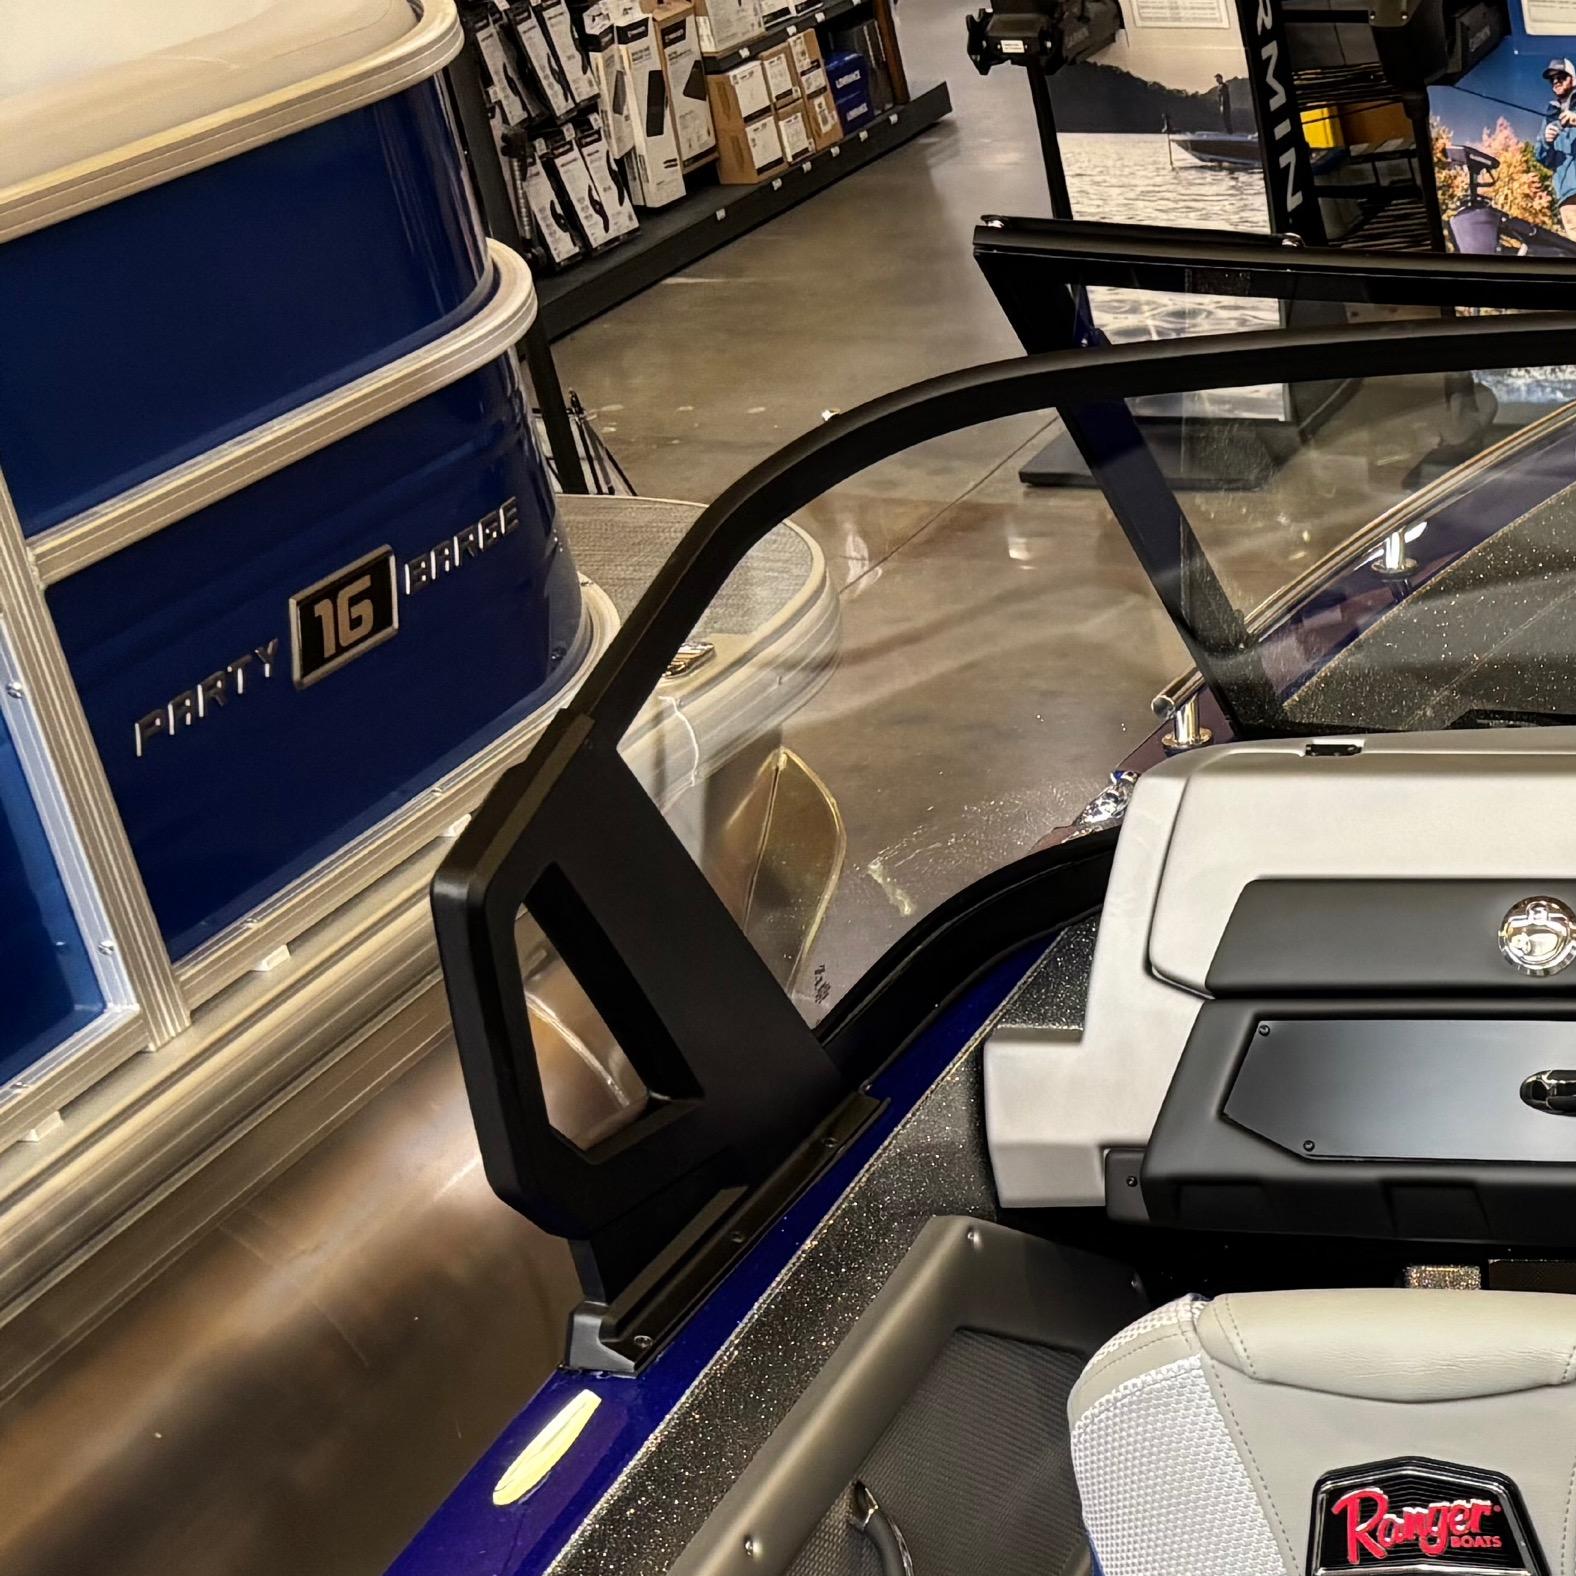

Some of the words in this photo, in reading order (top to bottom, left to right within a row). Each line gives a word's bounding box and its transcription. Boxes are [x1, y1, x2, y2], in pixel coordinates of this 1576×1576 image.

[135, 638, 279, 758] PARTY
[313, 574, 375, 659] 16
[403, 495, 521, 596] BARGE
[1331, 1486, 1492, 1565] Ranger
[1450, 1535, 1503, 1548] BOATS
